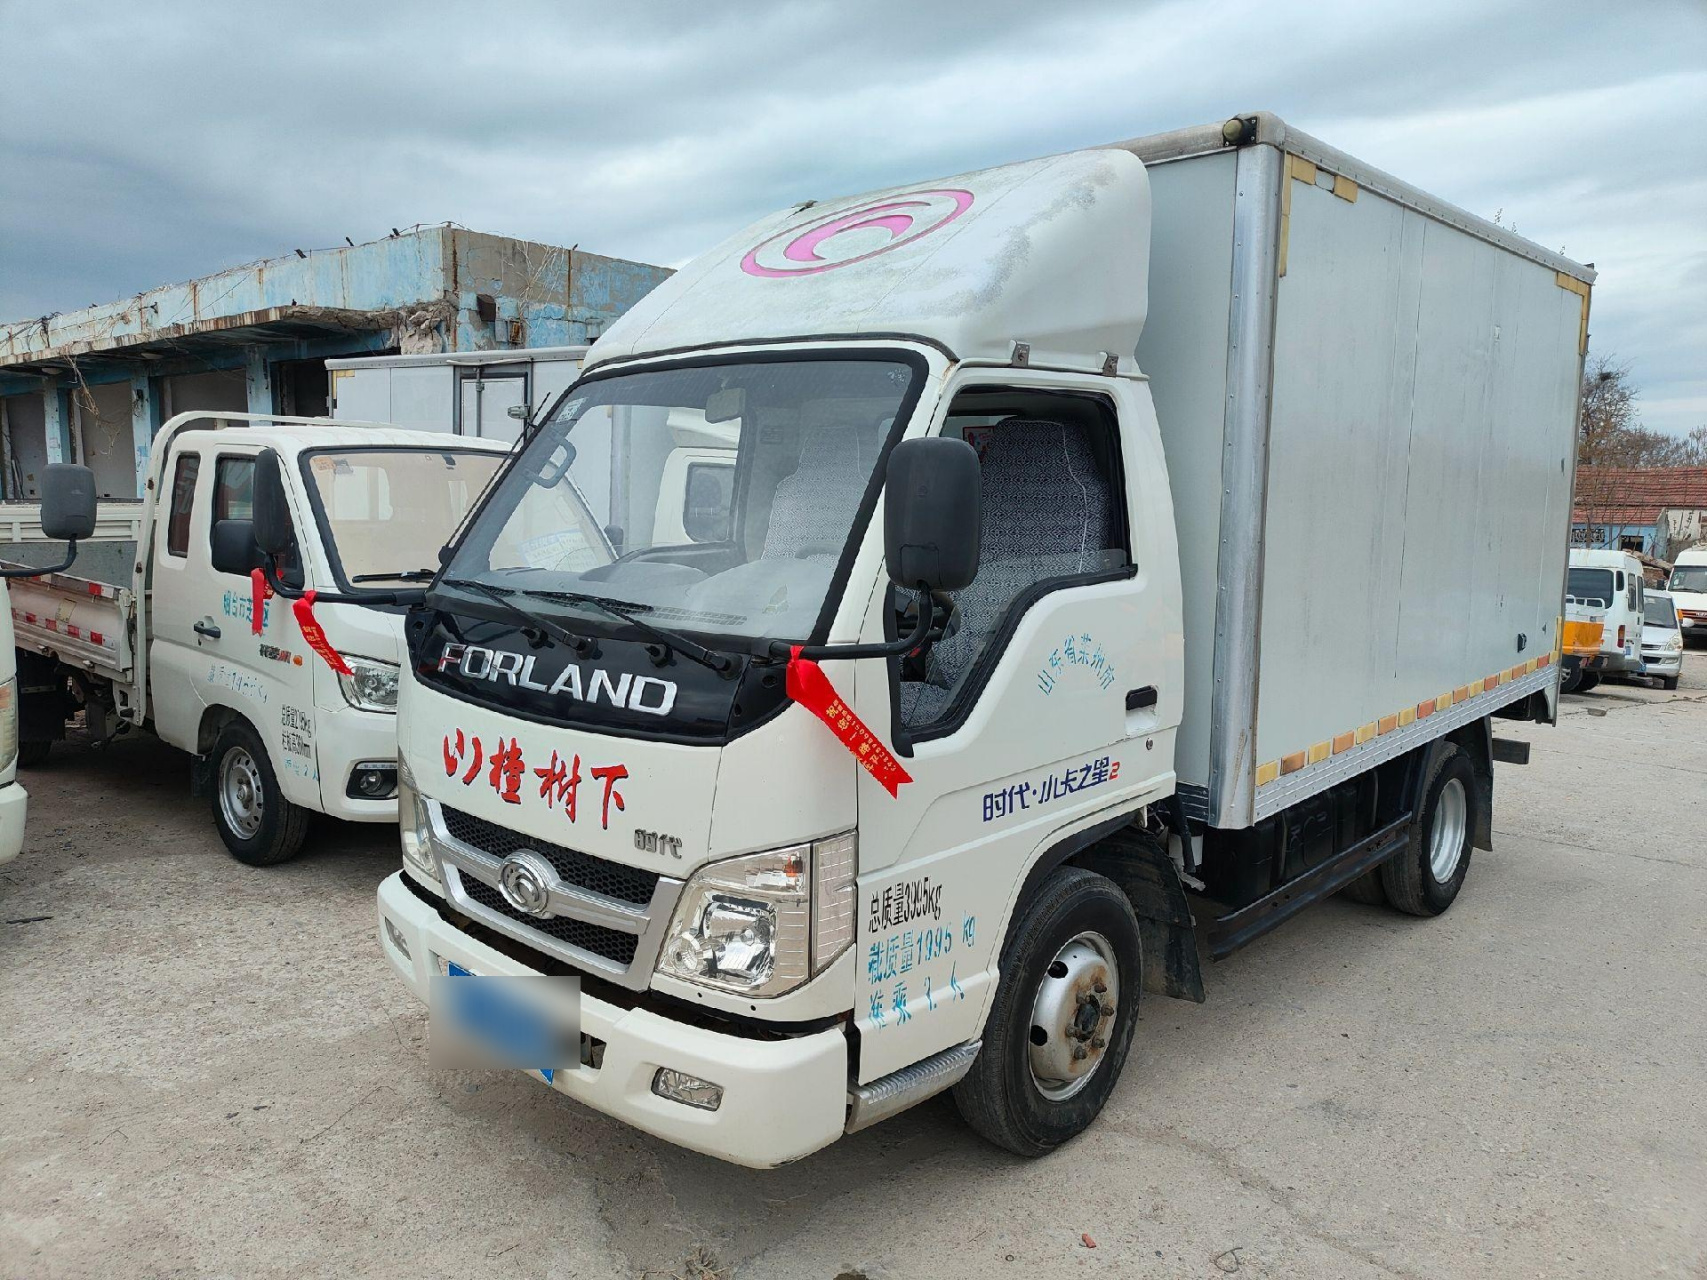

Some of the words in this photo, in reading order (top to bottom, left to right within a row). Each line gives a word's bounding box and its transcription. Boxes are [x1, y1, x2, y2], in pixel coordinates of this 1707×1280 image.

[437, 643, 677, 716] FORLAND
[634, 828, 683, 859] 时代
[869, 876, 942, 933] 总质量3995kg
